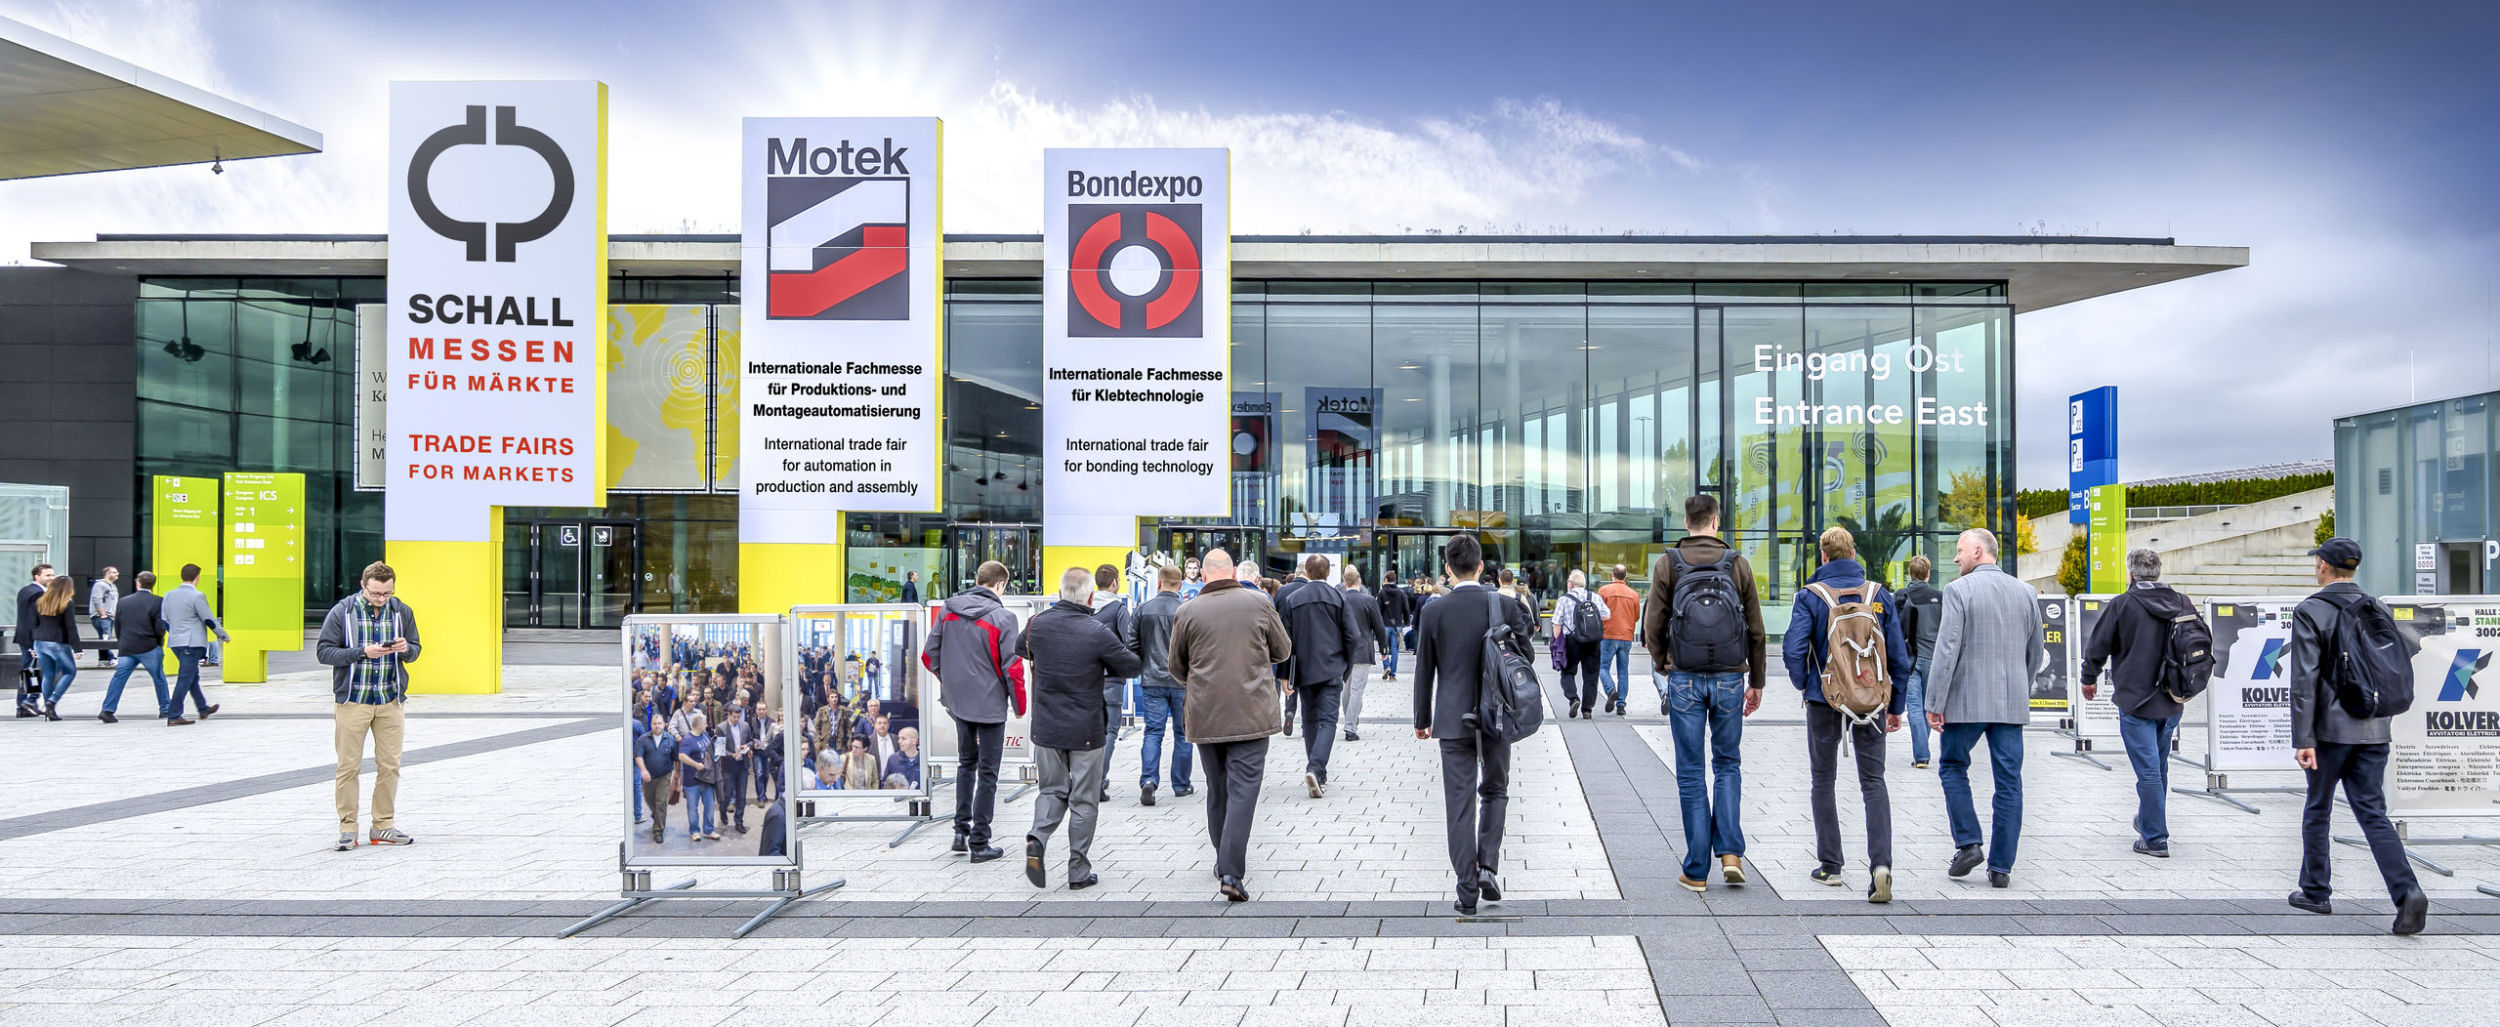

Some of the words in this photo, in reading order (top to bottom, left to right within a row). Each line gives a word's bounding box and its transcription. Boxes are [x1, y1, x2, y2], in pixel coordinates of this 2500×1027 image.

[768, 138, 909, 176] Motek
[1068, 170, 1203, 203] Bondexpo
[408, 294, 574, 327] SCHALL
[409, 337, 574, 363] MESSEN
[749, 361, 842, 375] Internationale
[846, 361, 922, 375] Fachmesse
[1754, 344, 1890, 380] Eingang
[1905, 344, 1965, 373] Ost
[408, 371, 457, 390] FÜR
[468, 372, 574, 393] MÄRKTE
[1049, 367, 1143, 381] Internationale
[1147, 367, 1223, 382] Fachmesse
[768, 382, 788, 396] für
[791, 382, 877, 397] Produktions-
[881, 382, 907, 397] und
[1071, 388, 1091, 402] für
[1095, 388, 1205, 405] Klebtechnologie
[753, 403, 921, 421] Montageautomatisierung
[1754, 397, 1903, 425] Entrance
[1917, 397, 1988, 426] East
[409, 434, 492, 453] TRADE
[502, 436, 574, 455] FAIRS
[764, 437, 844, 451] International
[848, 437, 882, 451] trade
[886, 437, 907, 451] fair
[1066, 437, 1146, 452] International
[1150, 438, 1184, 452] trade
[1187, 438, 1209, 452] fair
[409, 464, 454, 479] FOR
[463, 466, 574, 483] MARKETS
[782, 458, 801, 472] for
[804, 458, 877, 473] automation
[880, 458, 892, 472] in
[1064, 459, 1083, 473] for
[1086, 459, 1139, 476] bonding
[1142, 459, 1214, 476] technology
[260, 490, 277, 500] ICS
[755, 480, 825, 496] production
[828, 480, 854, 494] and
[857, 480, 918, 497] assembly
[2084, 489, 2090, 509] B
[2044, 631, 2061, 643] ER
[2242, 688, 2289, 702] KOLVE
[2426, 712, 2500, 730] KOLVER
